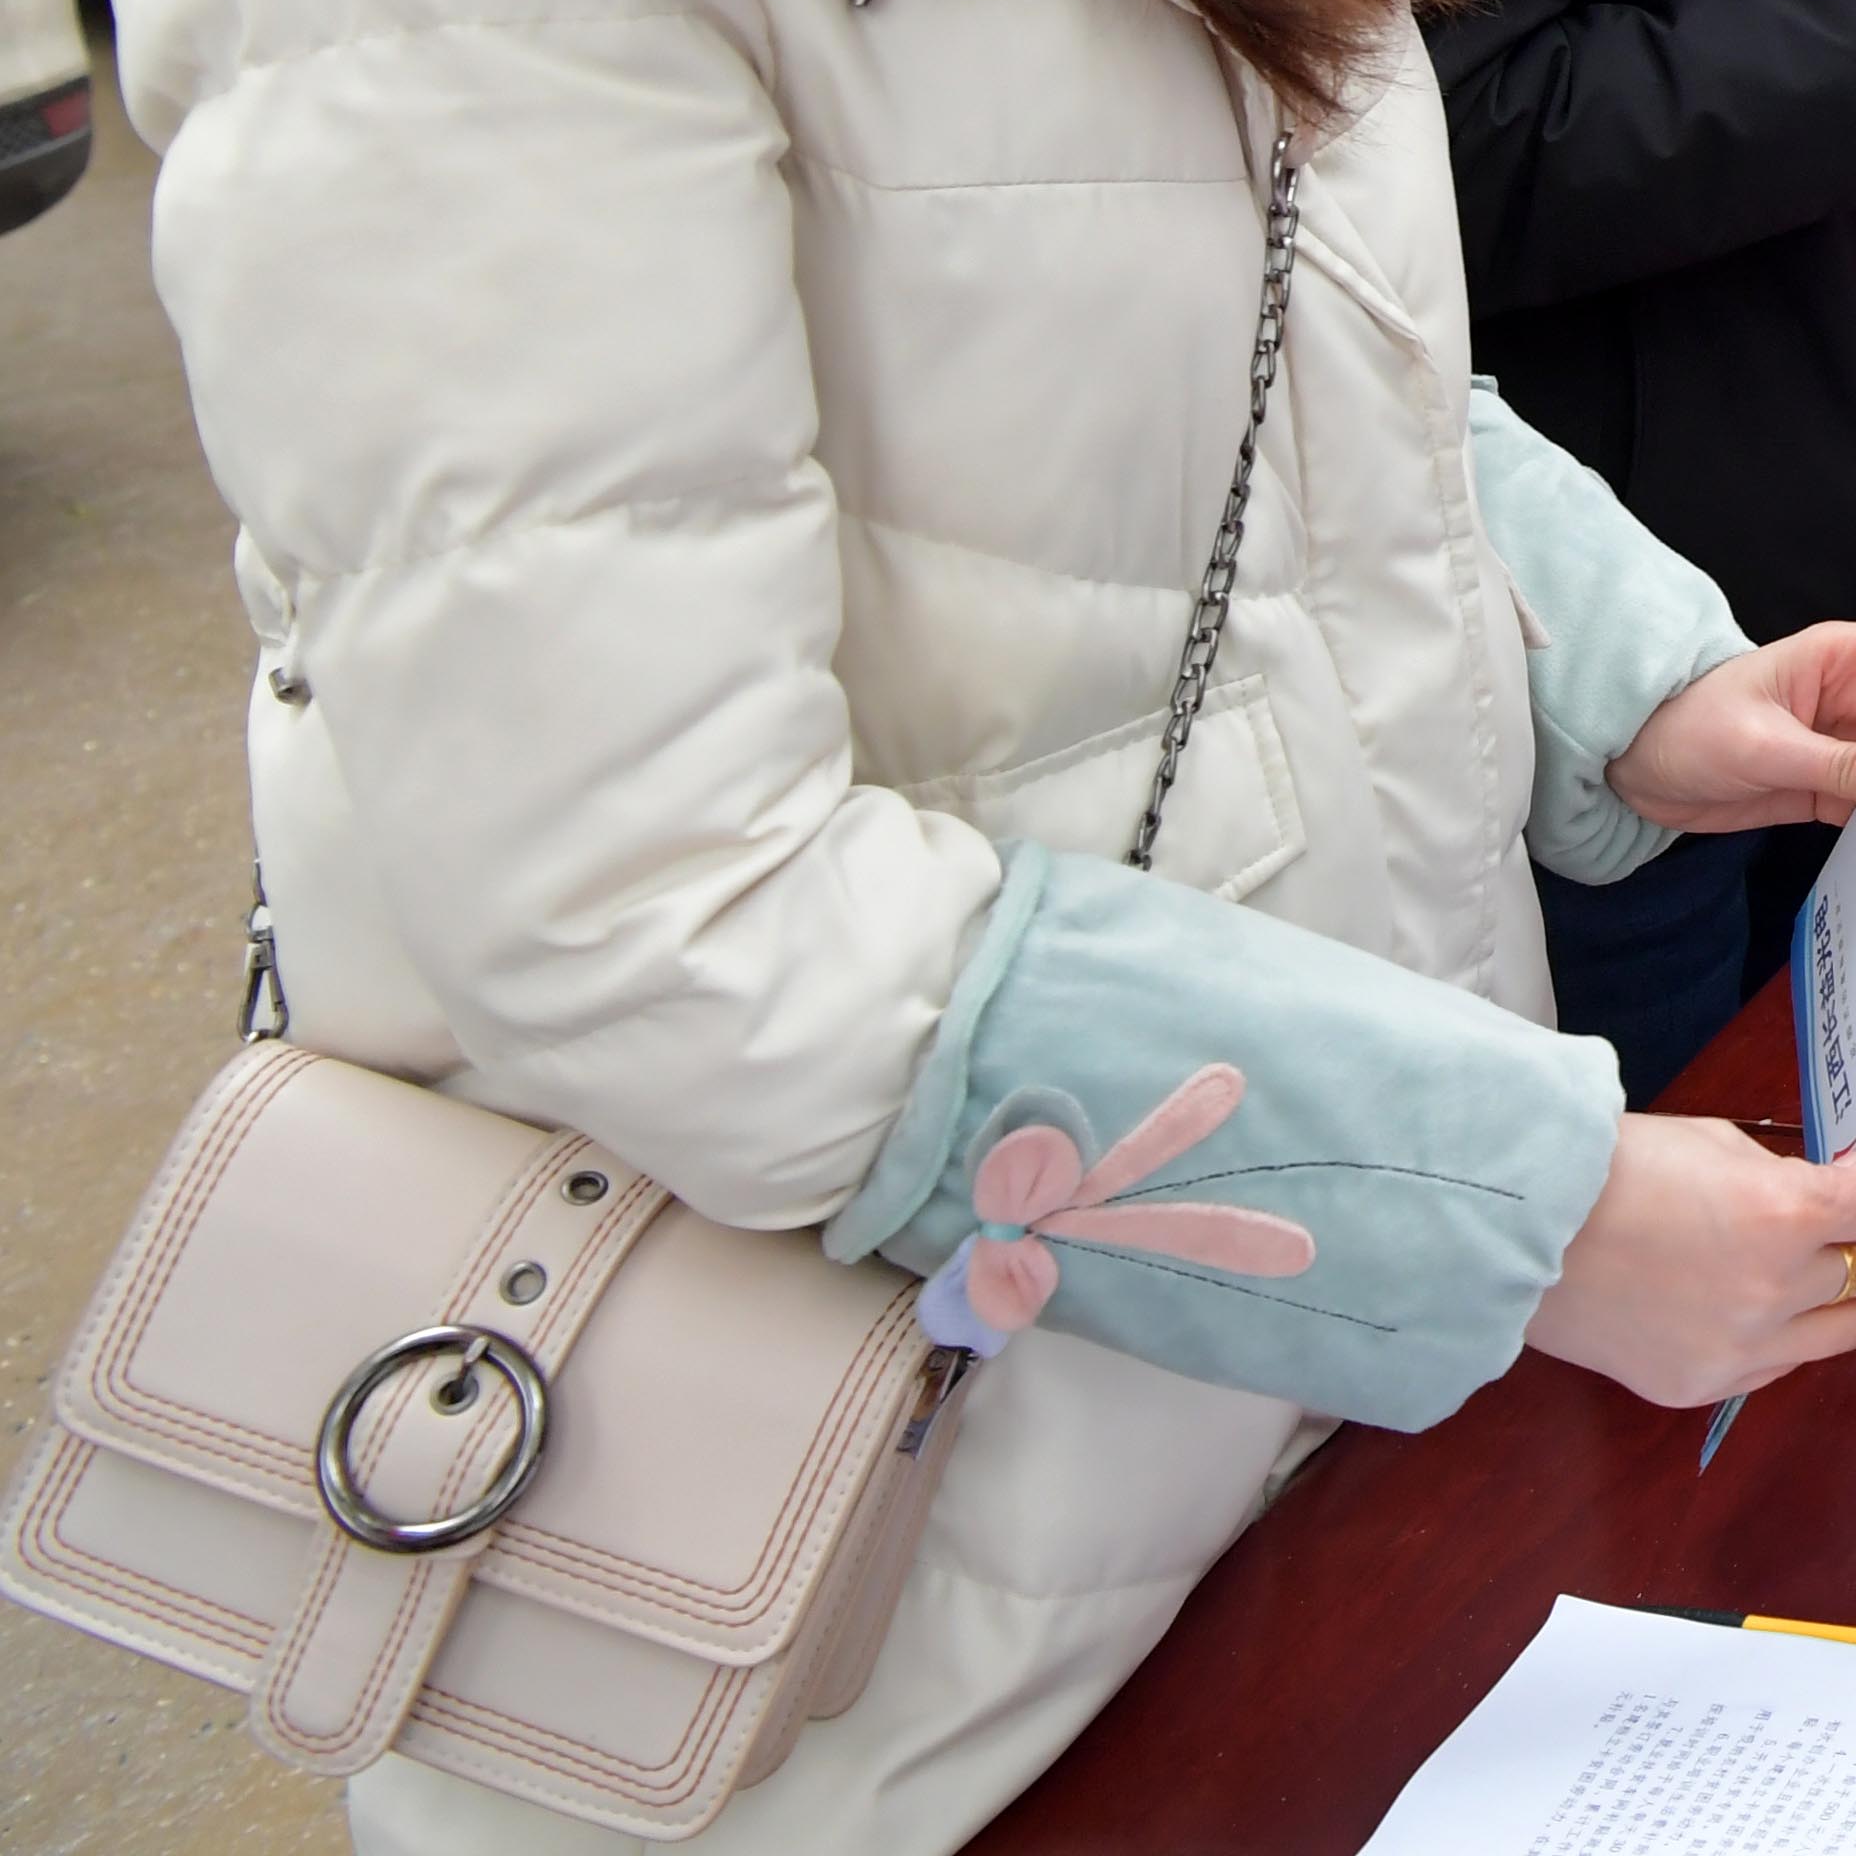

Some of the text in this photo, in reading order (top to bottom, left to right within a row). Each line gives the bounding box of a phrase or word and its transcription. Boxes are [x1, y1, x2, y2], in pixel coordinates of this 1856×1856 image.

[1813, 893, 1853, 1127] 江西长益光电
